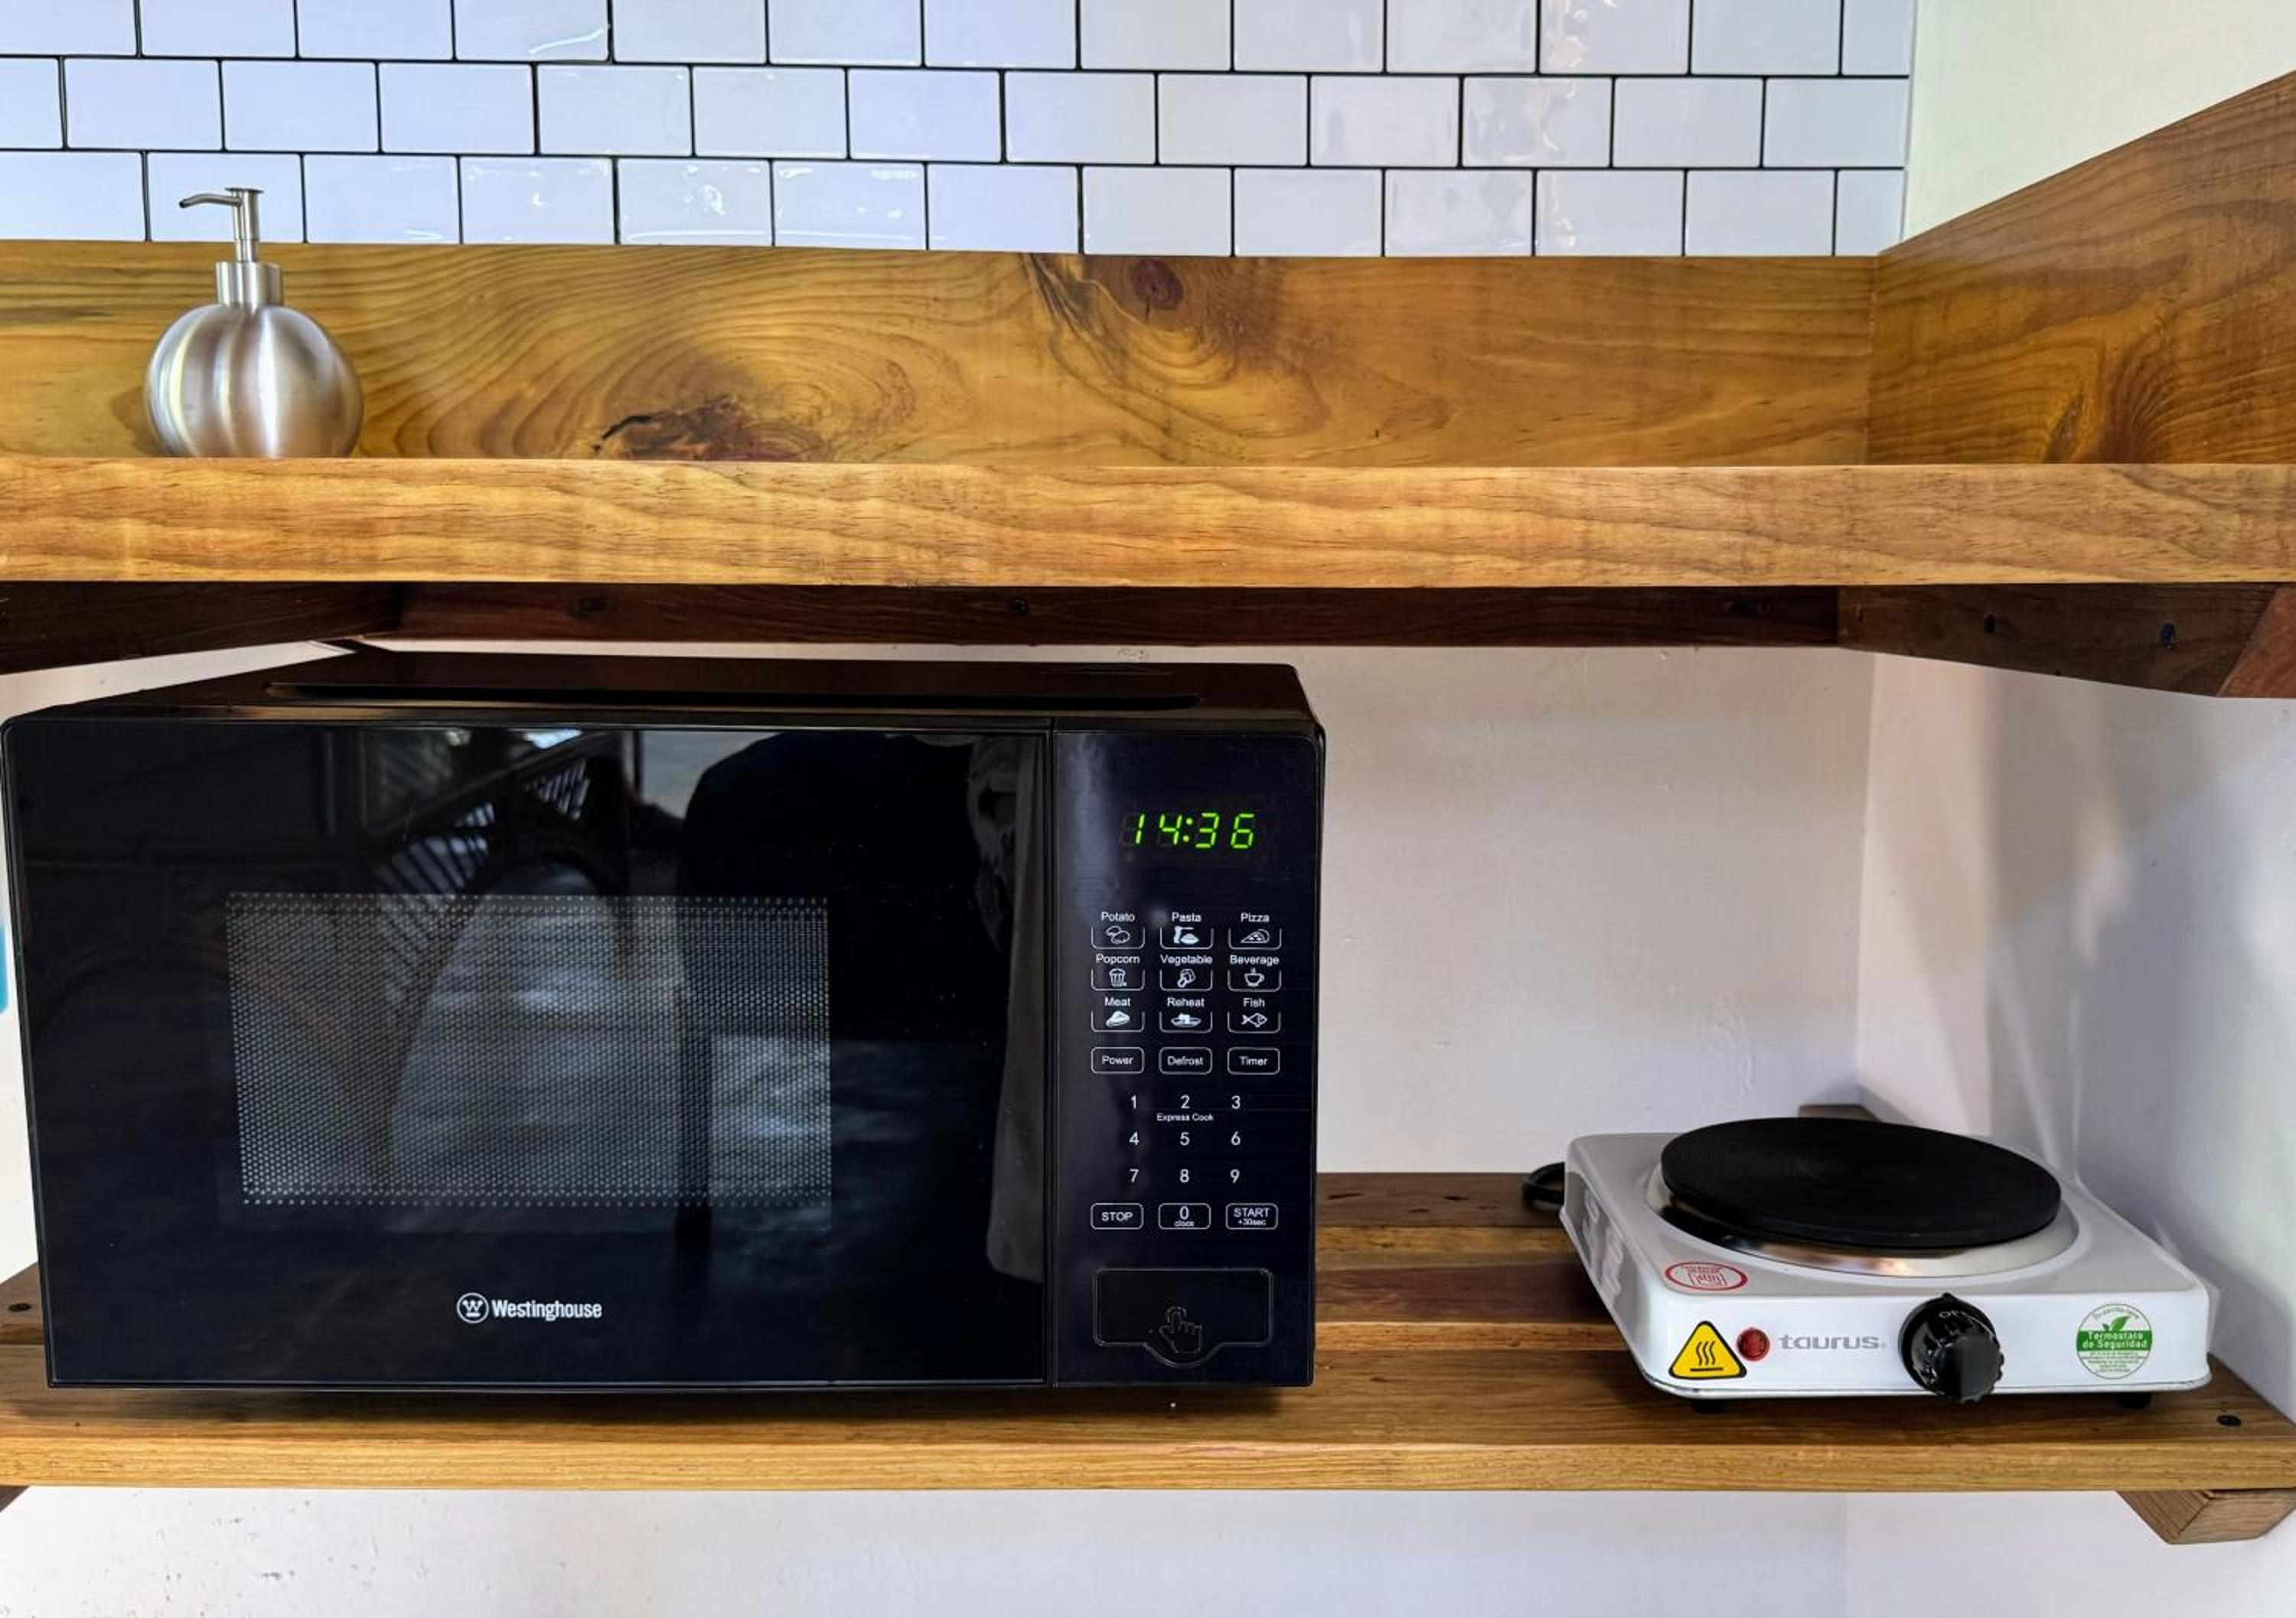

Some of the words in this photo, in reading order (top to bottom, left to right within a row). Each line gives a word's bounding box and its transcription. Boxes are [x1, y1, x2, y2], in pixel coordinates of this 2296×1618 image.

[1134, 811, 1256, 849] 14:36
[1101, 911, 1135, 922] Potato
[1171, 912, 1202, 922] Pasta
[1241, 912, 1270, 922] Pizza
[1095, 954, 1140, 967] Popcorn
[1159, 954, 1213, 967] Vegetable
[1229, 954, 1280, 967] Beverage
[1104, 997, 1131, 1006] Meat
[1166, 997, 1205, 1007] Reheat
[1243, 997, 1265, 1007] Fish
[1101, 1055, 1133, 1065] Power
[1167, 1055, 1204, 1066] Defrost
[1240, 1055, 1268, 1066] Timer
[1130, 1095, 1137, 1109] 1
[1180, 1094, 1190, 1110] 2
[1231, 1094, 1241, 1110] 3
[1156, 1113, 1190, 1123] Express
[1192, 1113, 1215, 1122] Cook
[1129, 1131, 1140, 1146] 4
[1179, 1131, 1190, 1146] 5
[1230, 1130, 1241, 1146] 6
[1130, 1169, 1140, 1183] 7
[1179, 1169, 1190, 1183] 8
[1230, 1169, 1240, 1183] 9
[1101, 1212, 1133, 1222] STOP
[1179, 1205, 1189, 1221] 0
[1233, 1207, 1270, 1218] START
[491, 1300, 602, 1322] Westinghouse
[1778, 1334, 1880, 1349] taurus
[2082, 1339, 2095, 1348] de
